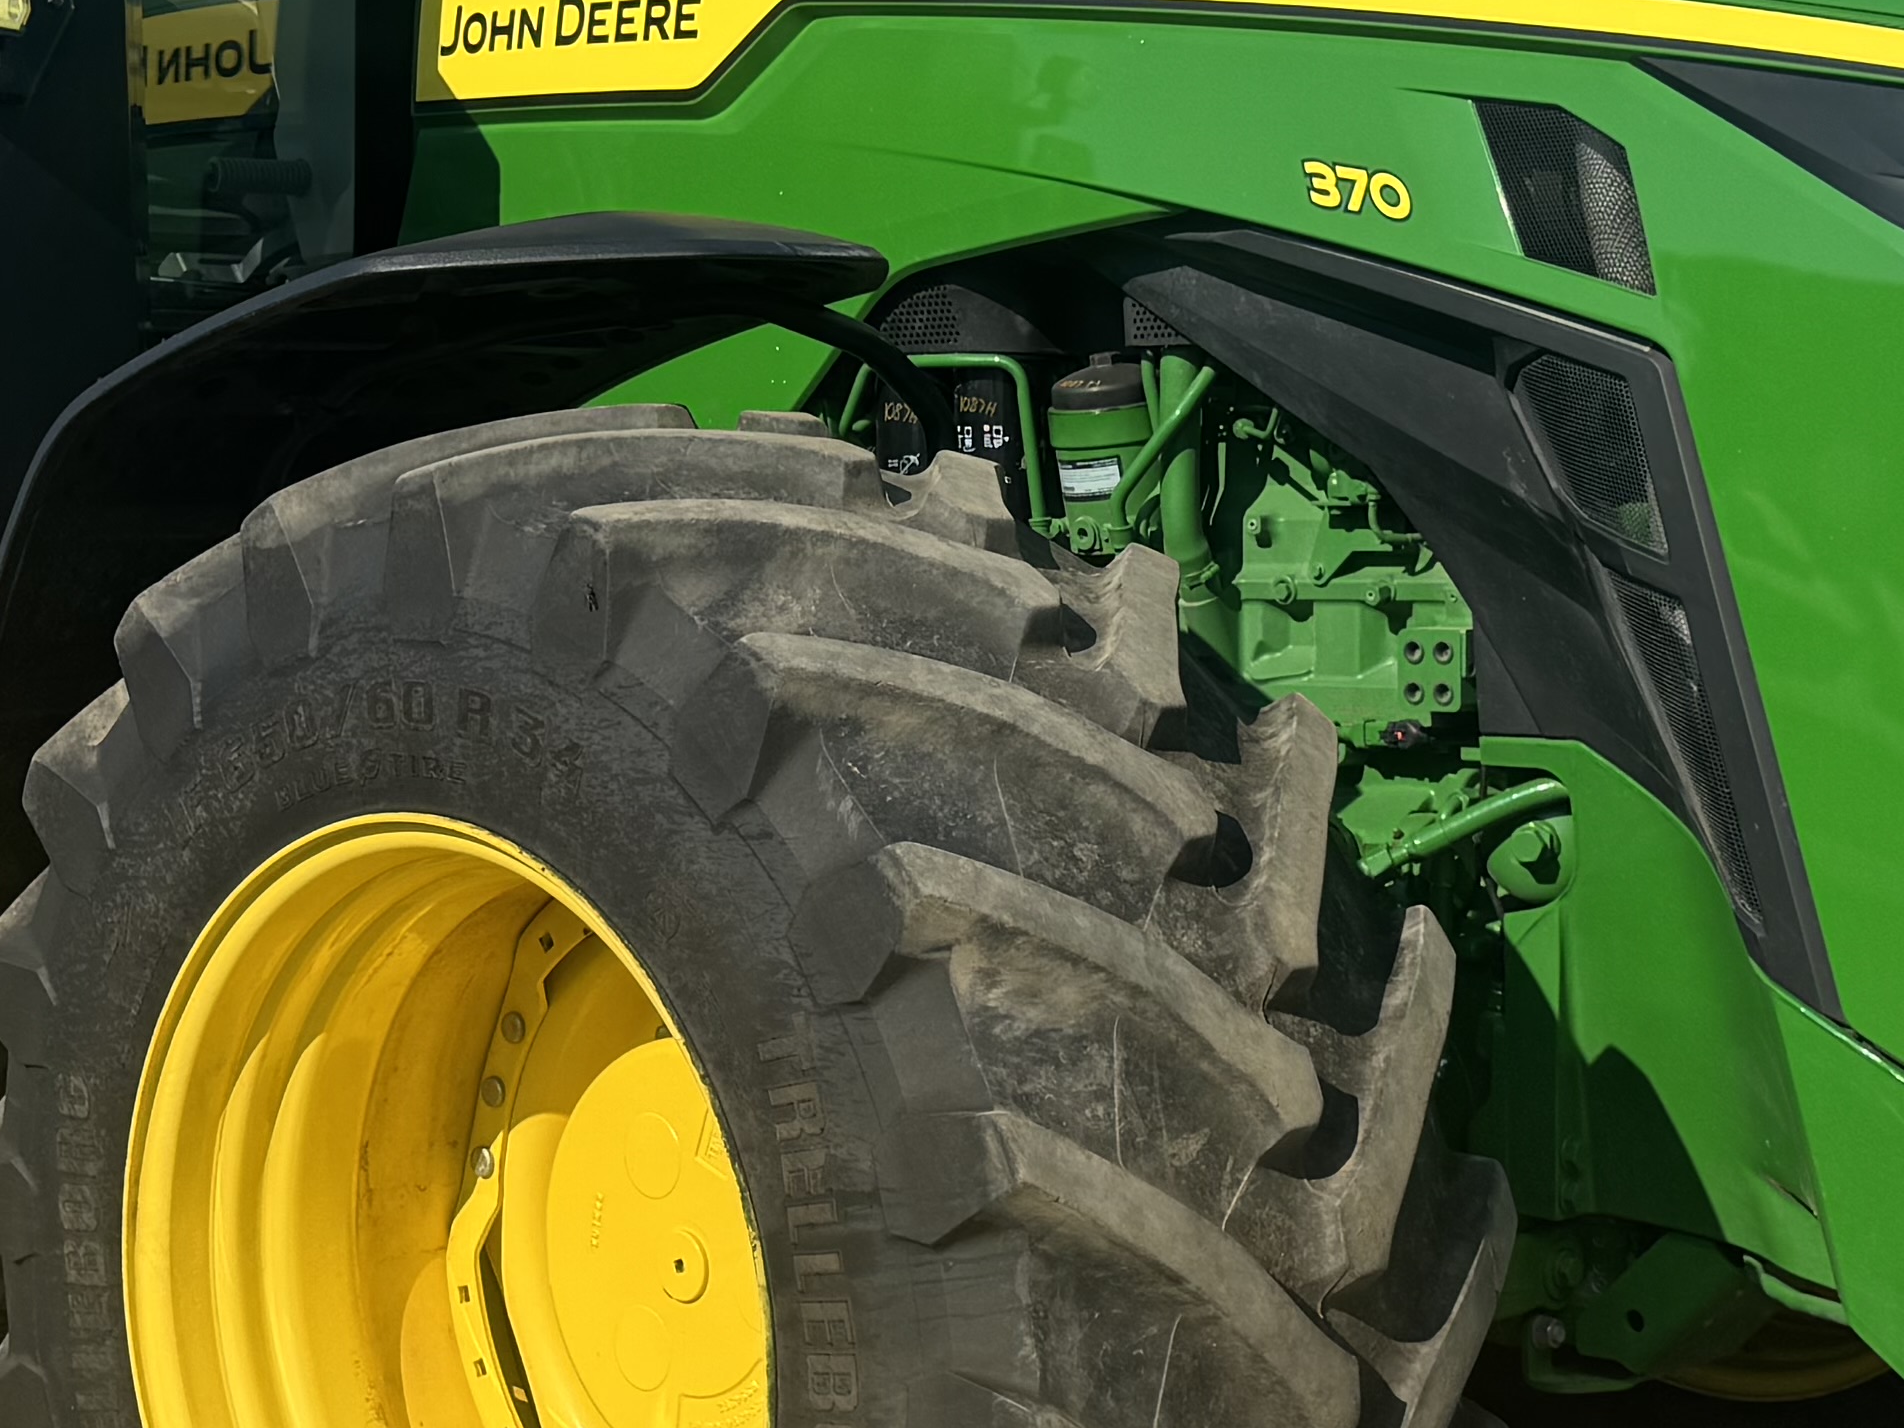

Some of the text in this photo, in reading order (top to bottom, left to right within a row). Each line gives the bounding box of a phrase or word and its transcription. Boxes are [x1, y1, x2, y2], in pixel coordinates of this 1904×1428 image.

[440, 6, 545, 56] JOHN
[1302, 159, 1412, 222] 370
[455, 681, 493, 748] R
